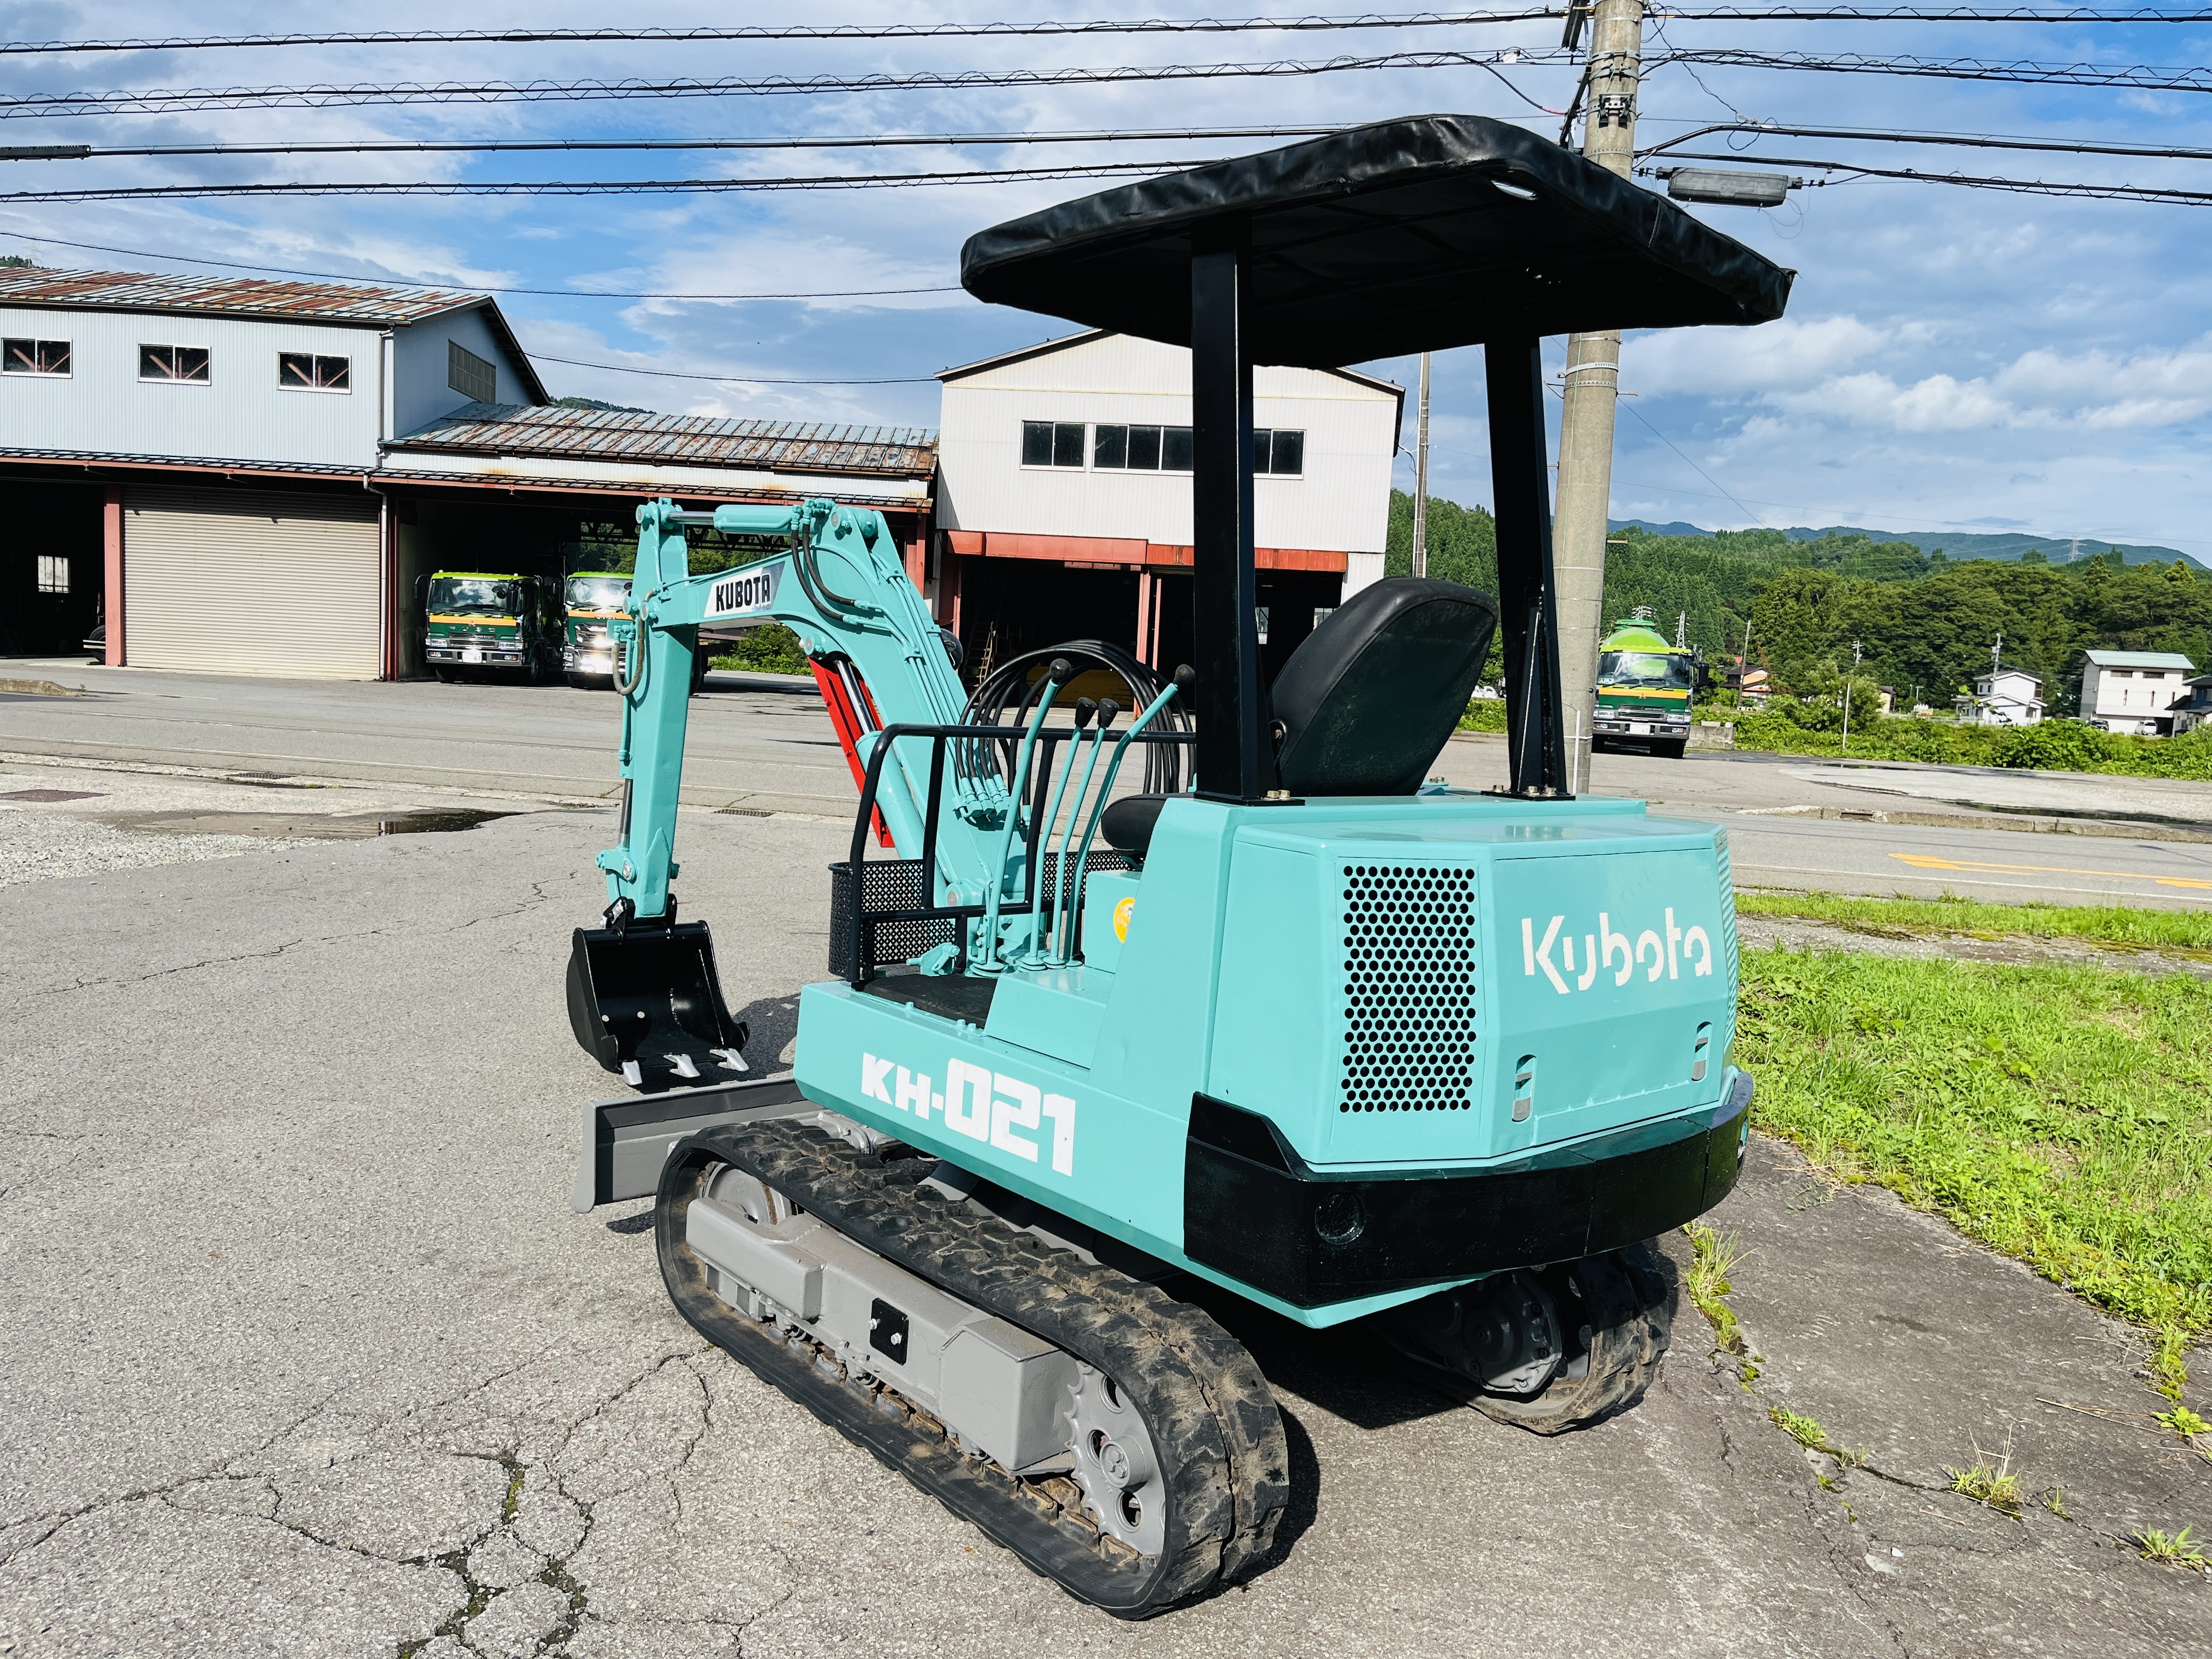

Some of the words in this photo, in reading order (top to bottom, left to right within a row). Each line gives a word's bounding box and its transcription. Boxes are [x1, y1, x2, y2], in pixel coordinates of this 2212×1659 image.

[715, 574, 770, 612] KUBOTA
[1521, 907, 1712, 994] Kubota
[861, 1052, 1076, 1177] KH-021
